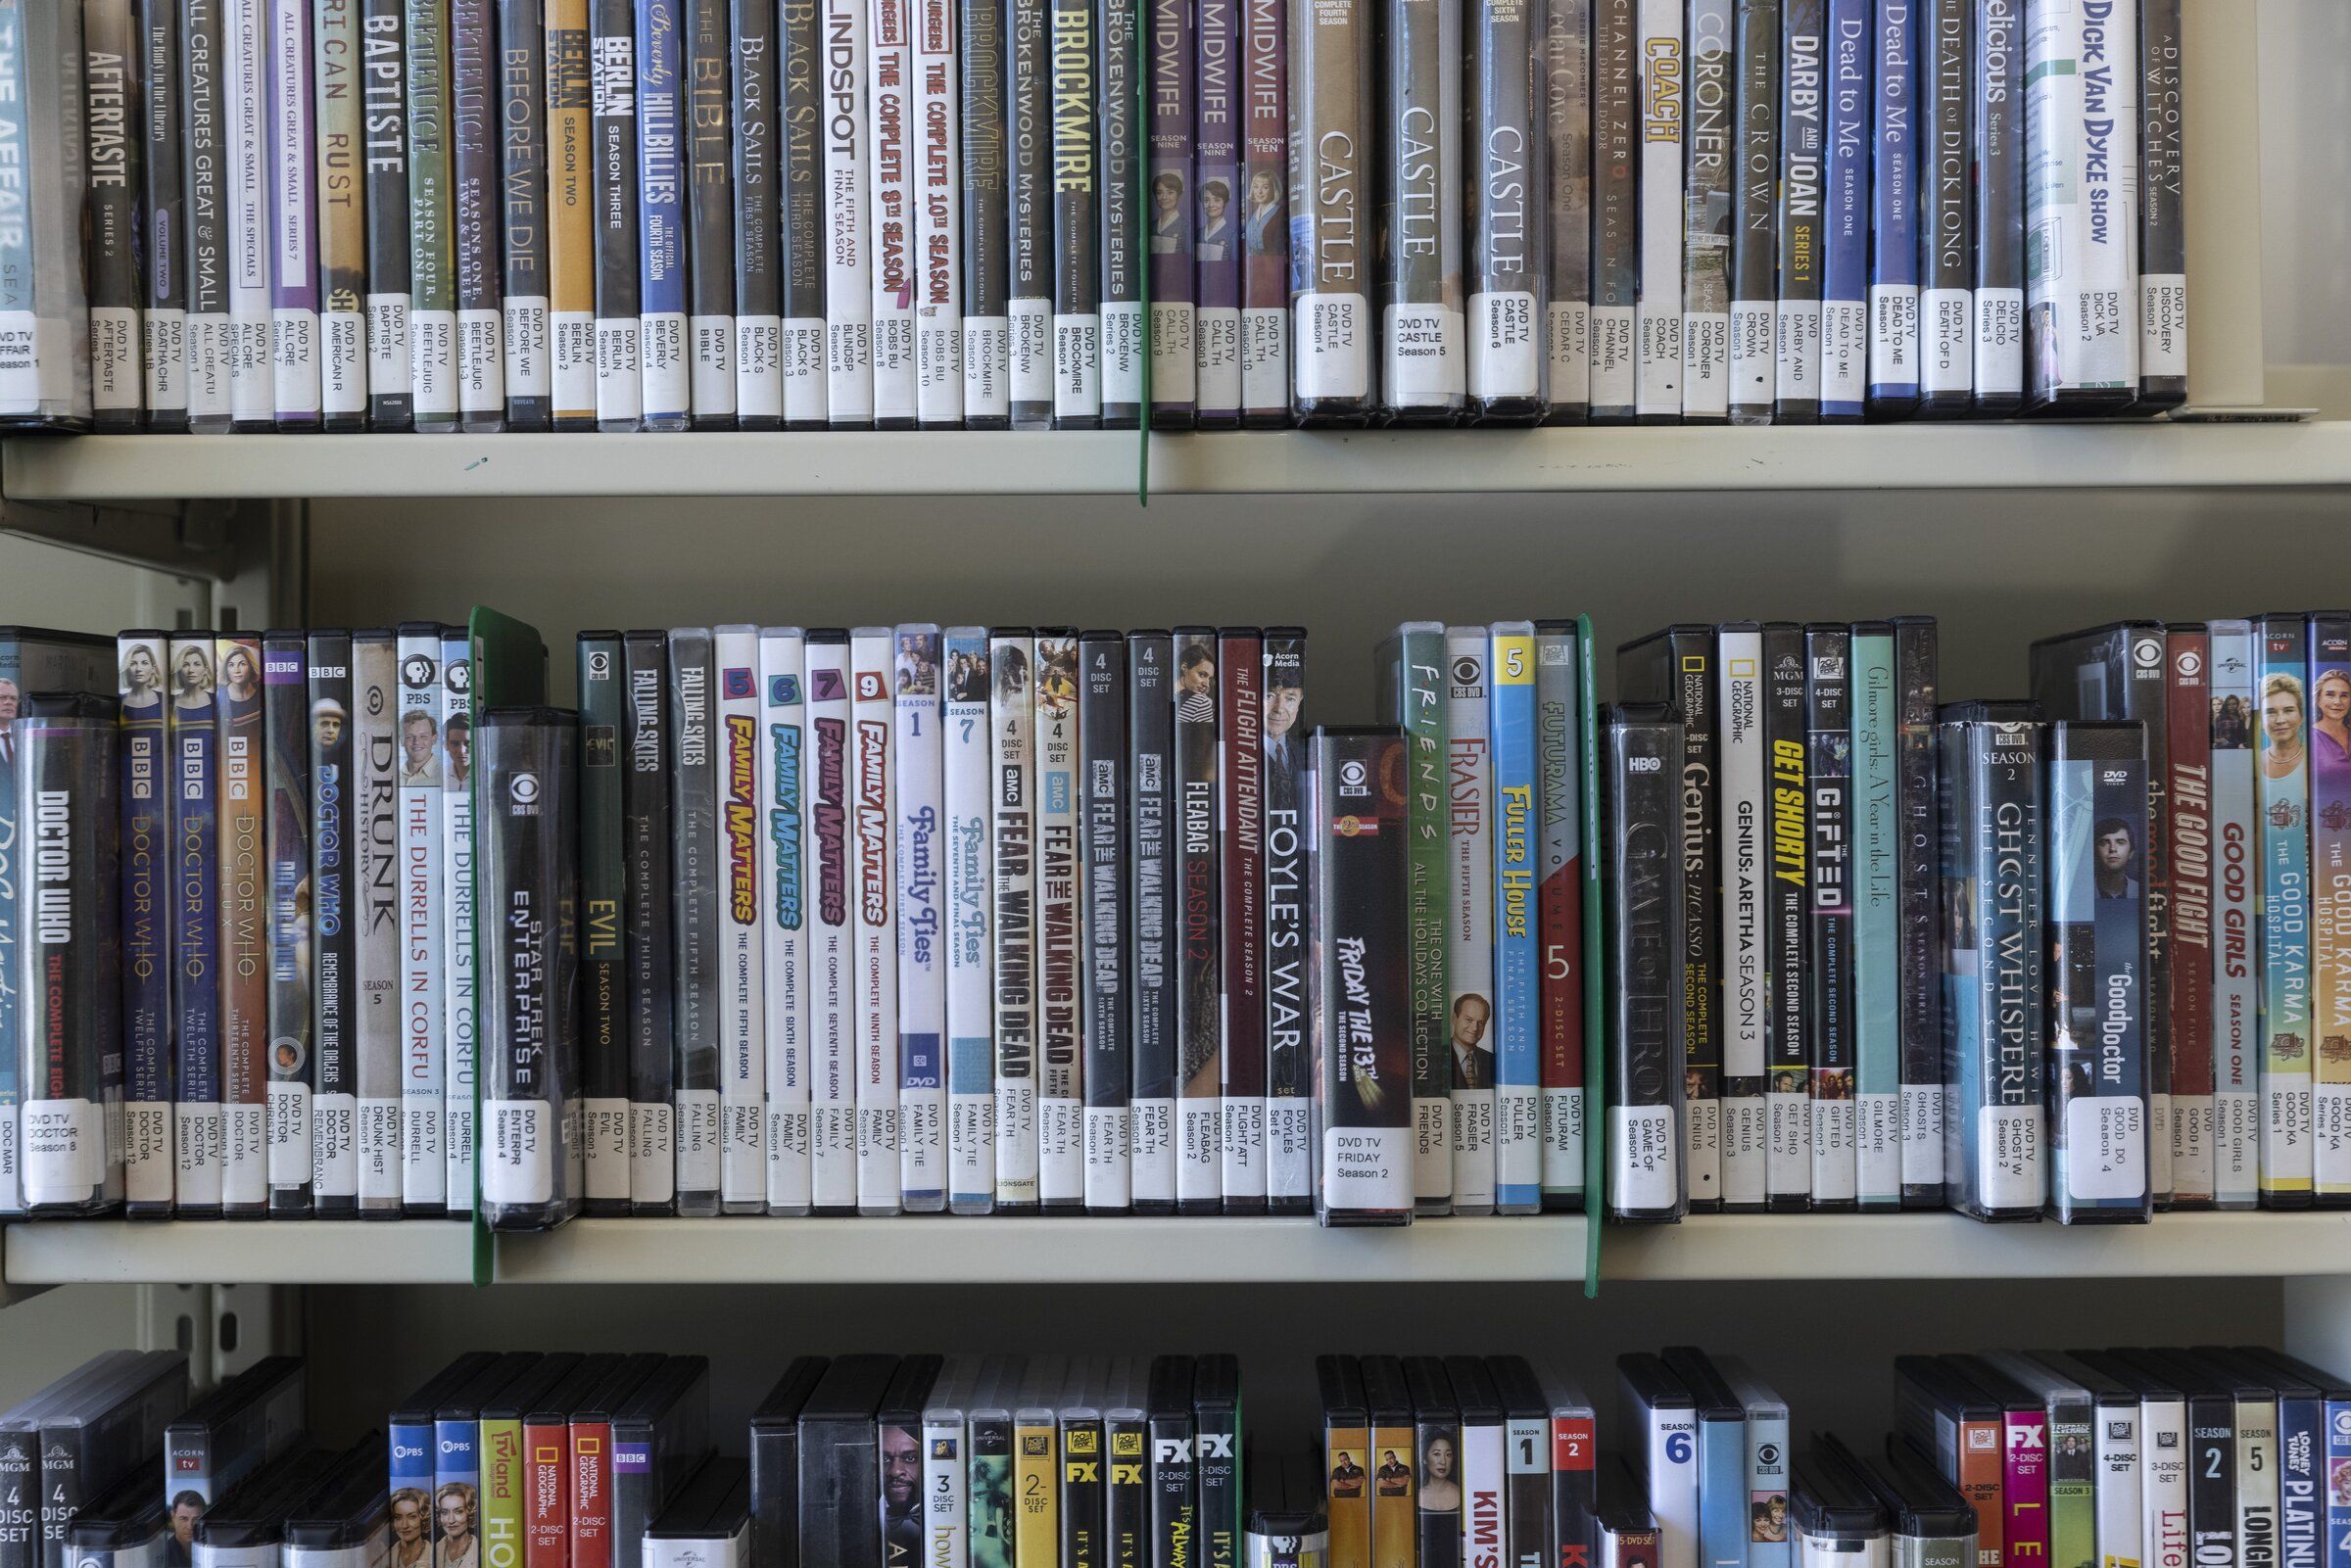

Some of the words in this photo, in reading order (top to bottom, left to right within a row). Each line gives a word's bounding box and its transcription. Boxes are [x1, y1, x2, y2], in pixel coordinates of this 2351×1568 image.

[284, 11, 294, 33] ALL
[1885, 5, 1907, 66] Dead
[284, 35, 296, 109] CREATURES
[363, 14, 404, 174] BAPTISTE
[593, 37, 605, 117] STATION
[604, 36, 634, 117] BERLIN
[926, 62, 946, 96] THE
[1645, 37, 1680, 143] COACH
[1694, 12, 1724, 168] CORONER
[1790, 35, 1819, 121] DARBY
[1886, 71, 1903, 96] to
[88, 51, 126, 188] AFTERTASTE
[504, 49, 532, 169] BEFORE
[694, 58, 725, 185] BIBLE
[1053, 9, 1092, 194] BROCKMIRE
[1886, 105, 1908, 143] Me
[286, 110, 297, 154] GREAT
[608, 125, 620, 180] SEASON
[644, 93, 675, 205] HILLBILLIES
[926, 101, 947, 186] COMPLETE
[1801, 126, 1818, 150] AND
[287, 155, 296, 165] &
[326, 133, 352, 209] RUST
[844, 168, 854, 192] THE
[288, 166, 299, 207] SMALL
[506, 168, 533, 215] WE
[610, 183, 622, 229] THREE
[834, 168, 843, 204] FINAL
[1400, 107, 1436, 260] CASTLE
[1790, 152, 1818, 215] JOAN
[289, 214, 298, 250] SERIES
[845, 194, 855, 229] FIFTH
[290, 251, 298, 260] 7
[508, 225, 534, 271] DIE
[835, 211, 844, 265] SEASON
[845, 236, 856, 267] AND
[1795, 225, 1810, 270] SERIES
[929, 234, 949, 304] SEASON
[1795, 272, 1810, 282] 1
[381, 305, 392, 359] BAPTISTE
[1398, 318, 1420, 329] DVD
[1424, 318, 1440, 329] TV
[1398, 332, 1442, 343] CASTLE
[843, 323, 853, 372] BLINDSP
[1398, 347, 1435, 356] Season
[1438, 347, 1446, 356] 5
[309, 667, 346, 678] BBC
[1236, 667, 1249, 684] THE
[1506, 648, 1523, 677] 5
[1773, 671, 1803, 681] MGM
[406, 693, 431, 704] PBS
[633, 668, 659, 729] FALLING
[1237, 687, 1257, 749] FLIGHT
[1732, 680, 1743, 743] GEOGRAPHIC
[1743, 681, 1754, 730] NATIONAL
[635, 732, 659, 773] SKIES
[960, 719, 975, 744] 7
[1047, 742, 1068, 751] DISC
[1052, 723, 1062, 738] 4
[725, 714, 756, 799] FAMILY
[1049, 754, 1066, 763] SET
[1542, 701, 1567, 827] FUTURAMA
[1629, 757, 1661, 772] HBO
[1773, 738, 1803, 784] GET
[1237, 753, 1259, 854] ATTENDANT
[1450, 737, 1486, 836] FRASIER
[2174, 763, 2207, 811] THE
[37, 790, 70, 881] DOCTOR
[316, 764, 340, 869] DOCTOR
[370, 734, 396, 935] DRUNK
[409, 794, 427, 837] THE
[1186, 782, 1210, 854] FLEABAG
[1502, 784, 1533, 864] FULLER
[1737, 799, 1752, 873] GENIUS:
[1774, 787, 1805, 886] SHORTY
[725, 800, 756, 926] MATTERS
[1044, 825, 1072, 878] FEAR
[2174, 808, 2208, 879] GOOD
[2223, 822, 2244, 903] GOOD
[1045, 881, 1072, 898] THE
[1269, 809, 1300, 949] FOYLE'S
[38, 888, 71, 944] WHO
[317, 874, 340, 935] WHO
[410, 846, 428, 962] DURRELLS
[1502, 870, 1532, 939] HOUSE
[1738, 876, 1752, 952] ARETHA
[2174, 879, 2208, 949] FIGHT
[590, 900, 616, 955] EVIL
[738, 932, 747, 950] THE
[2224, 908, 2246, 978] GIRLS
[530, 921, 543, 981] STAR
[1045, 902, 1073, 1002] WALKING
[362, 980, 394, 990] SEASON
[373, 994, 382, 1005] 5
[411, 971, 428, 992] IN
[514, 890, 532, 1084] ENTERPRISE
[600, 963, 610, 1011] SEASON
[738, 953, 748, 1005] COMPLETE
[1739, 955, 1755, 1026] SEASON
[531, 994, 544, 1056] TREK
[739, 1009, 748, 1037] FIFTH
[1271, 961, 1301, 1052] WAR
[2230, 994, 2241, 1050] SEASON
[411, 1001, 429, 1079] CORFU
[600, 1015, 610, 1045] TWO
[1045, 1006, 1074, 1065] DEAD
[1740, 1030, 1755, 1040] 3
[739, 1040, 748, 1079] SEASON
[2231, 1054, 2242, 1085] ONE
[373, 1107, 382, 1144] DRUNK
[2286, 1092, 2295, 1124] GOOD
[511, 1110, 521, 1165] ENTERPR
[1337, 1138, 1364, 1147] DVD
[1366, 1138, 1381, 1147] TV
[1337, 1153, 1380, 1163] FRIDAY
[2286, 1126, 2296, 1146] KA
[373, 1146, 383, 1174] HIST
[1337, 1168, 1377, 1178] Season
[1381, 1168, 1388, 1178] 2
[406, 1448, 423, 1456] PBS
[1155, 1440, 1192, 1463] FX
[1520, 1439, 1532, 1464] 1
[1568, 1444, 1578, 1456] 2
[1665, 1433, 1692, 1464] 6
[2194, 1428, 2231, 1438] SEASON
[2288, 1436, 2298, 1472] TUNES
[2298, 1431, 2311, 1477] LOONEY
[616, 1453, 646, 1462] BBC
[2205, 1449, 2221, 1478] 2
[2251, 1448, 2262, 1471] 5
[537, 1465, 548, 1518] GEOGRAPHIC
[548, 1465, 556, 1507] NATIONAL
[936, 1475, 950, 1493] 3
[531, 1526, 564, 1535] 2-DISC
